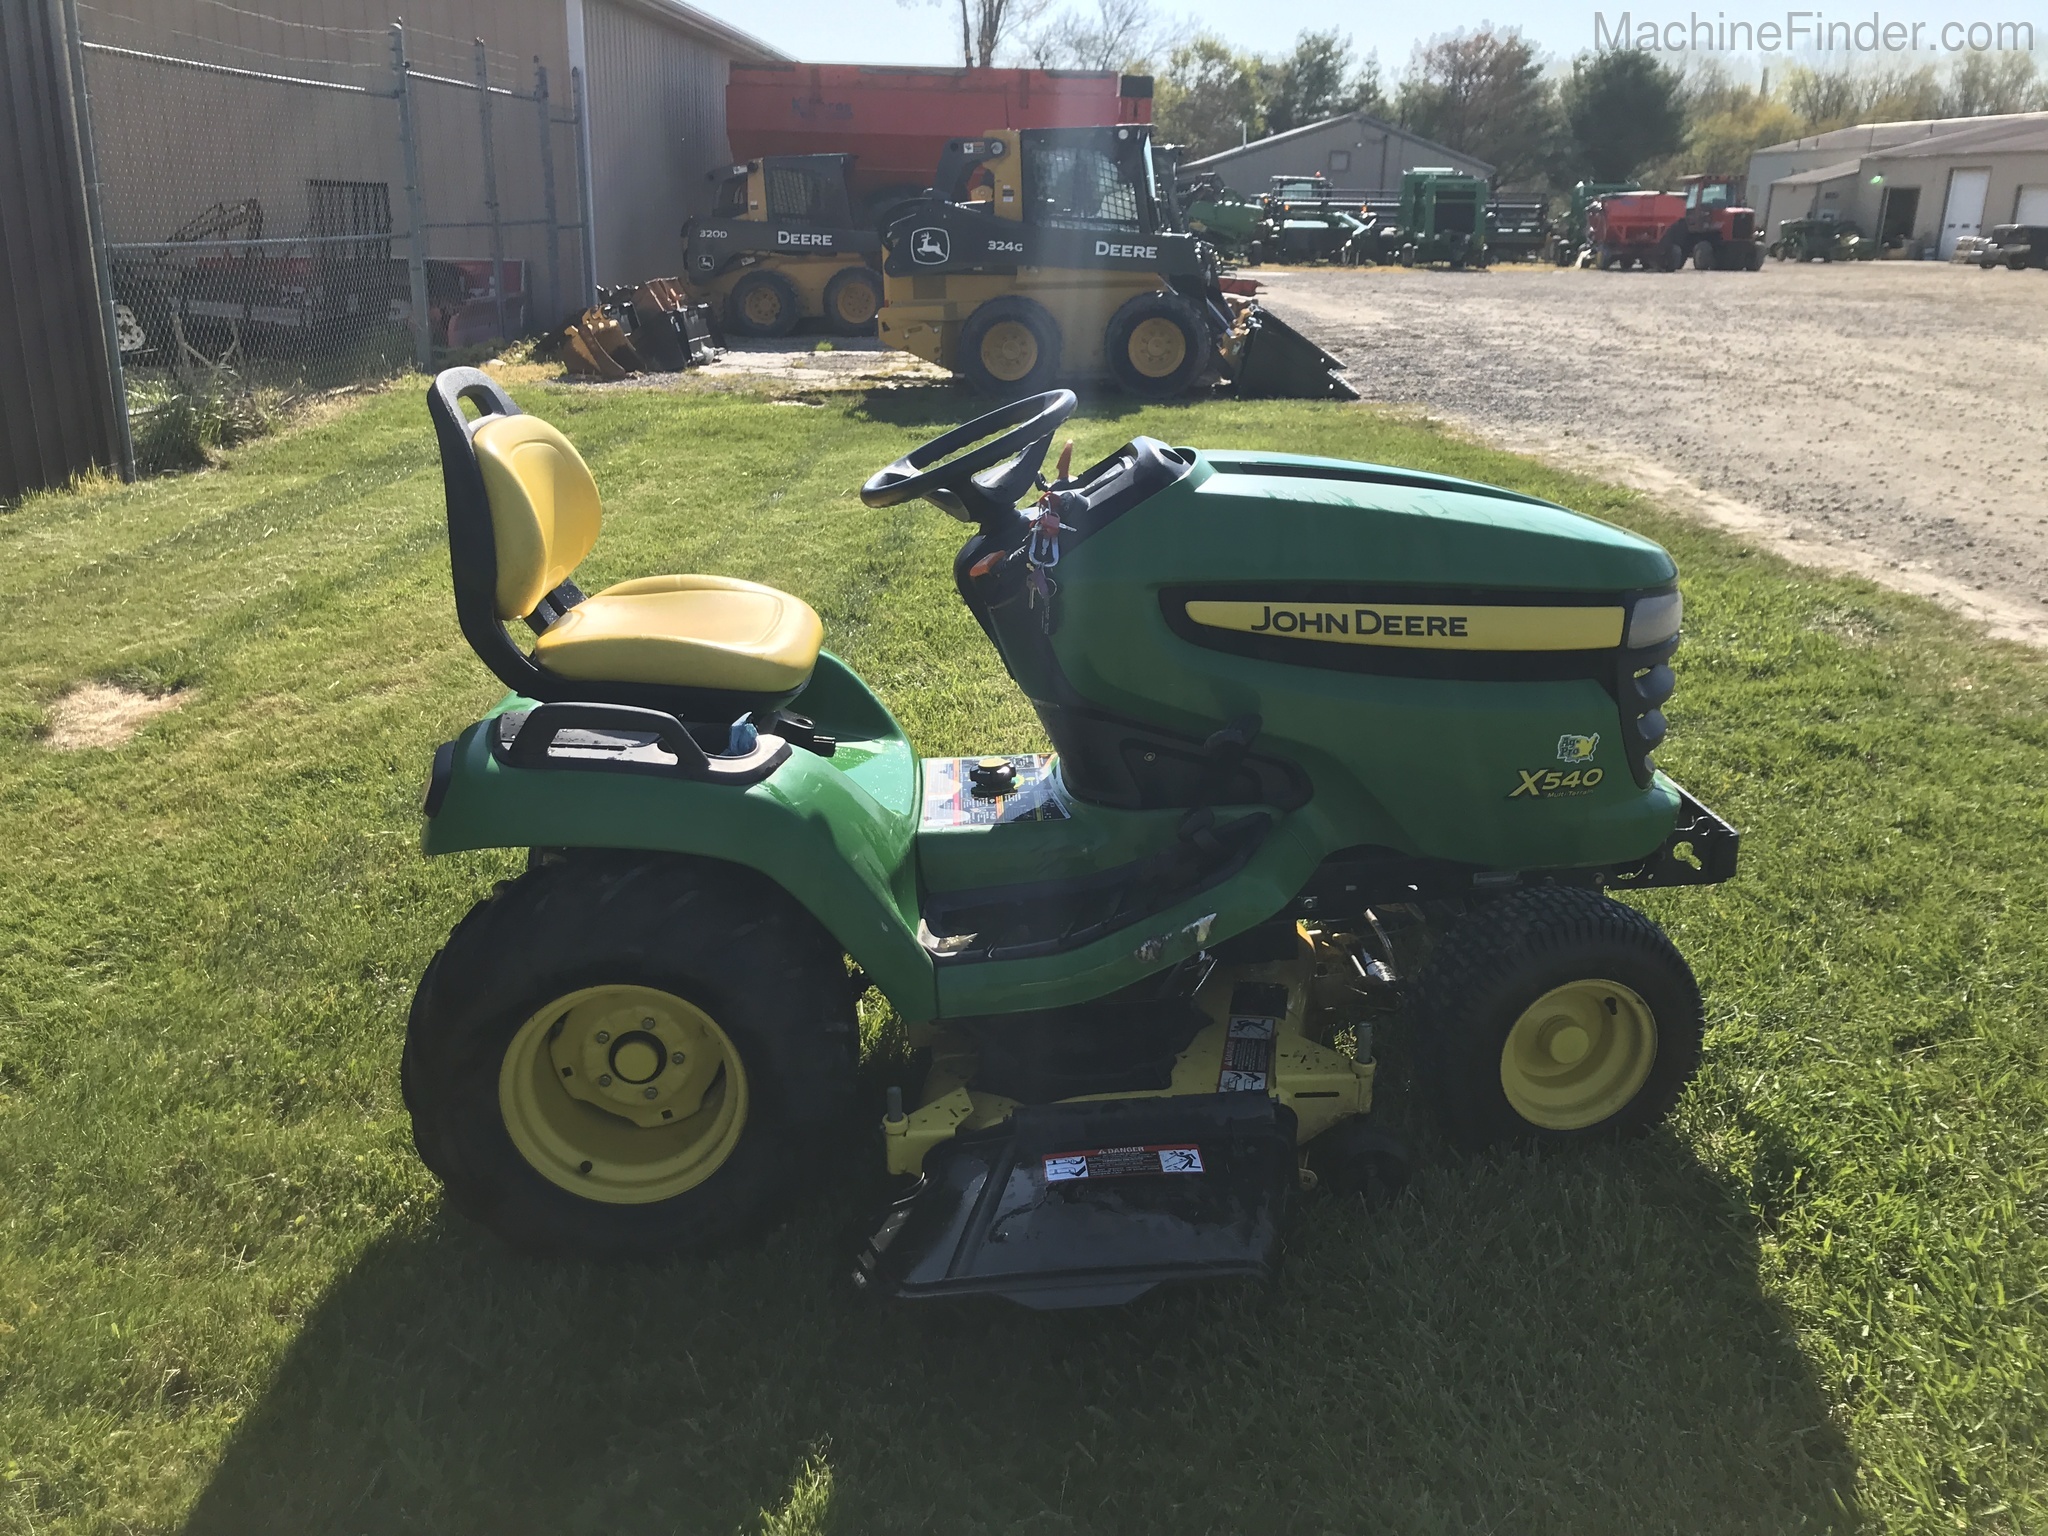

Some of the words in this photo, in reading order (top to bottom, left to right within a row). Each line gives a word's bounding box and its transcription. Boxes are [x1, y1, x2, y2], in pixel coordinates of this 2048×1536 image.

[699, 229, 728, 239] 320D
[777, 231, 833, 246] DEERE
[987, 240, 1023, 252] 324G
[1095, 241, 1158, 259] DEERE
[1250, 606, 1349, 634] JOHN
[1355, 609, 1468, 637] DEERE
[1508, 768, 1604, 797] X540
[1108, 1146, 1145, 1154] DANGER
